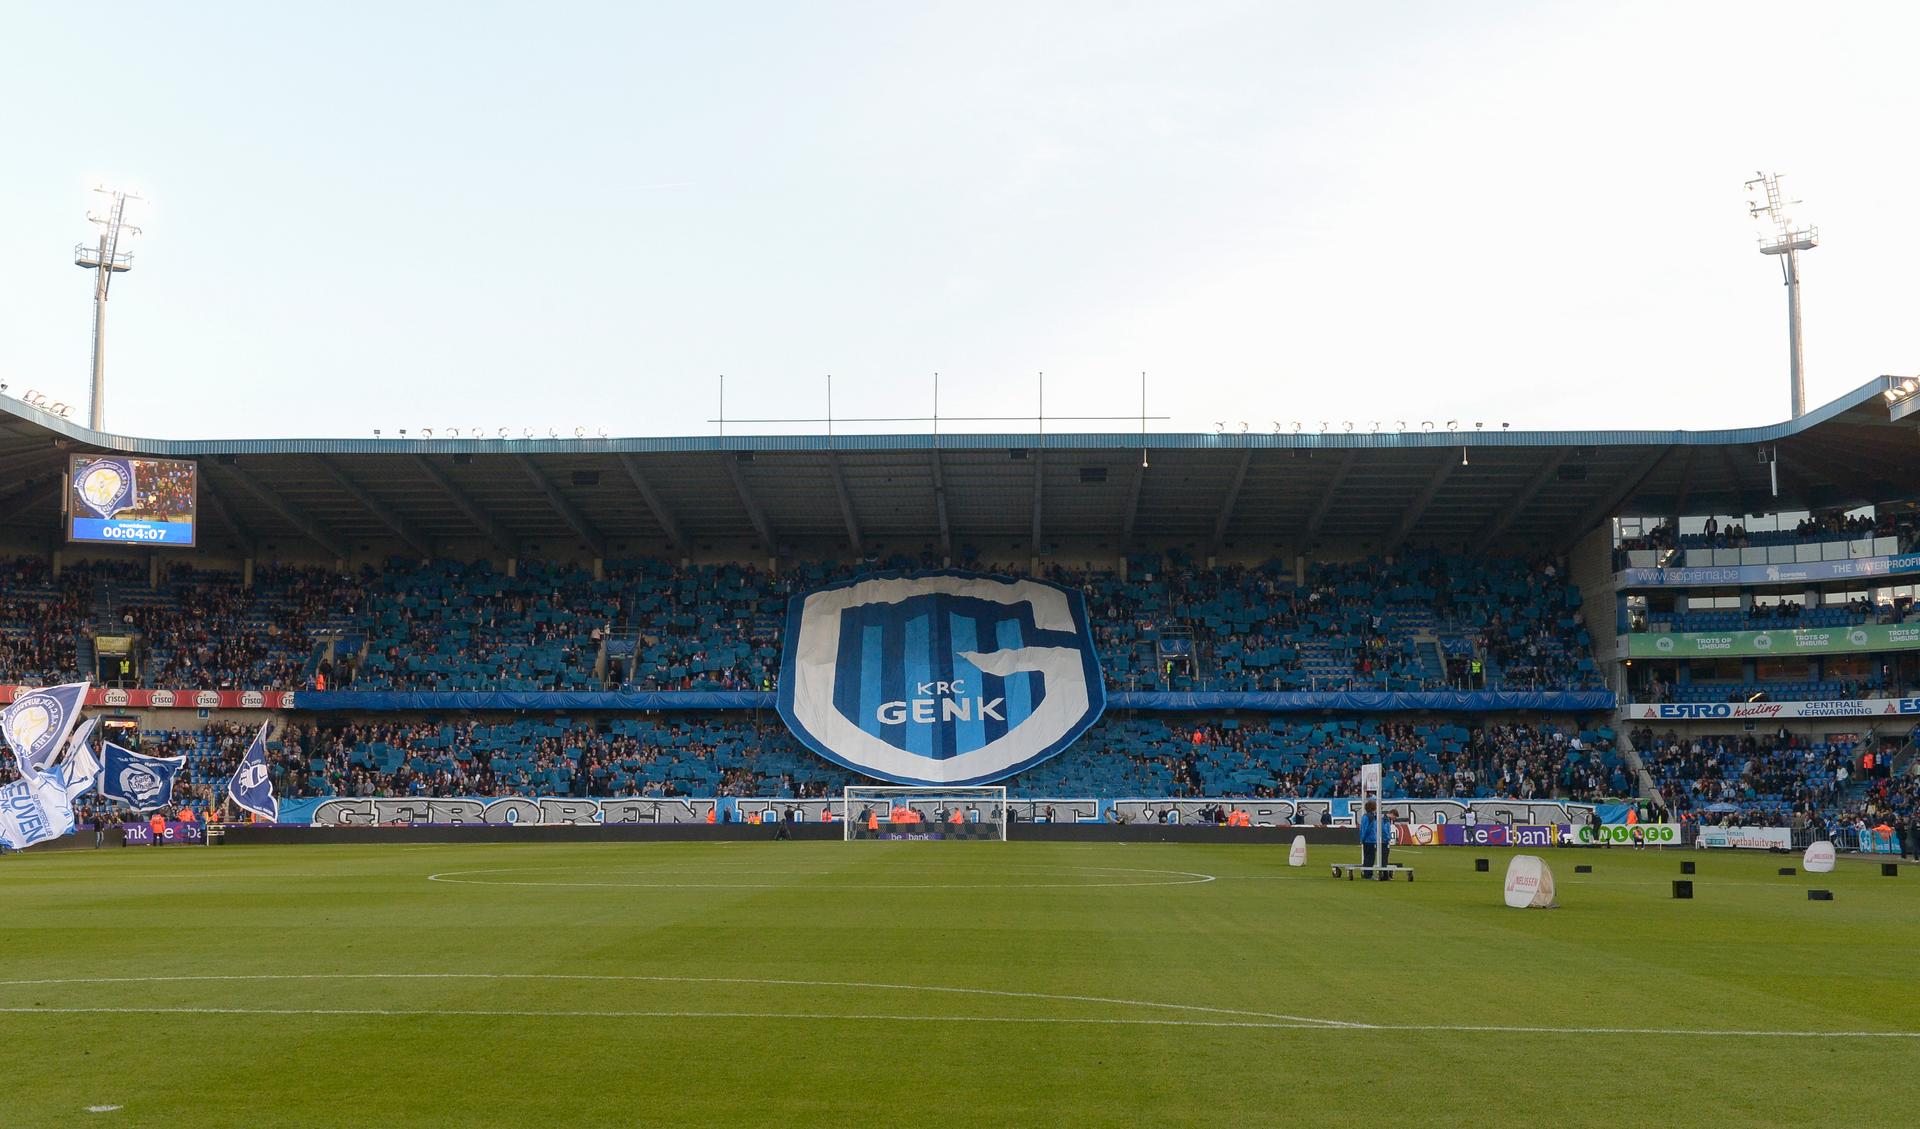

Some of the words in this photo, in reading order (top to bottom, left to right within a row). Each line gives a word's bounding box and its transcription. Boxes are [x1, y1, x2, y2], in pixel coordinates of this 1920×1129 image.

[103, 526, 167, 540] 00:04:07
[1832, 564, 1852, 574] THE
[1855, 558, 1920, 572] WATERPROOFI
[917, 679, 965, 696] KRC
[876, 696, 1006, 725] GENK
[1733, 702, 1784, 718] heating
[1797, 707, 1873, 716] VERWARMING
[1805, 700, 1863, 709] CENTRALE
[312, 798, 717, 825] GEBOREN
[1582, 829, 1672, 840] UNIET
